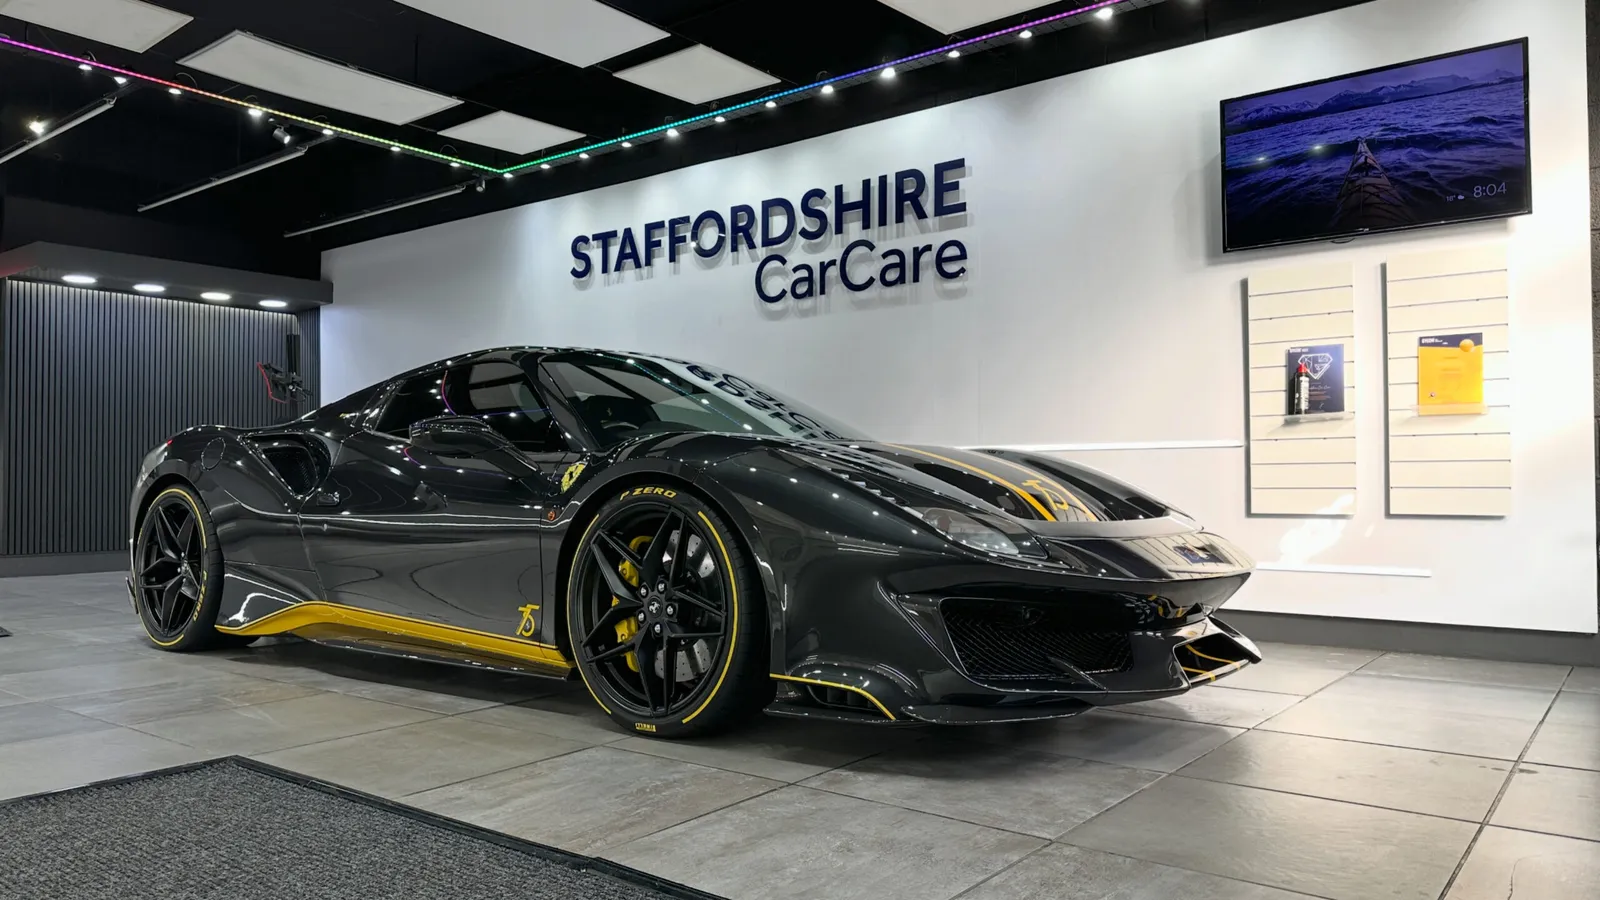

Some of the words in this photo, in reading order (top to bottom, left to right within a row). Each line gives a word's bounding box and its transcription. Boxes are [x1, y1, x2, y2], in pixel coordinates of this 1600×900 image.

[1473, 182, 1507, 198] 8:04
[570, 157, 967, 279] STAFFORDSHIRE
[754, 239, 967, 303] CarCare
[632, 486, 677, 498] ZERO
